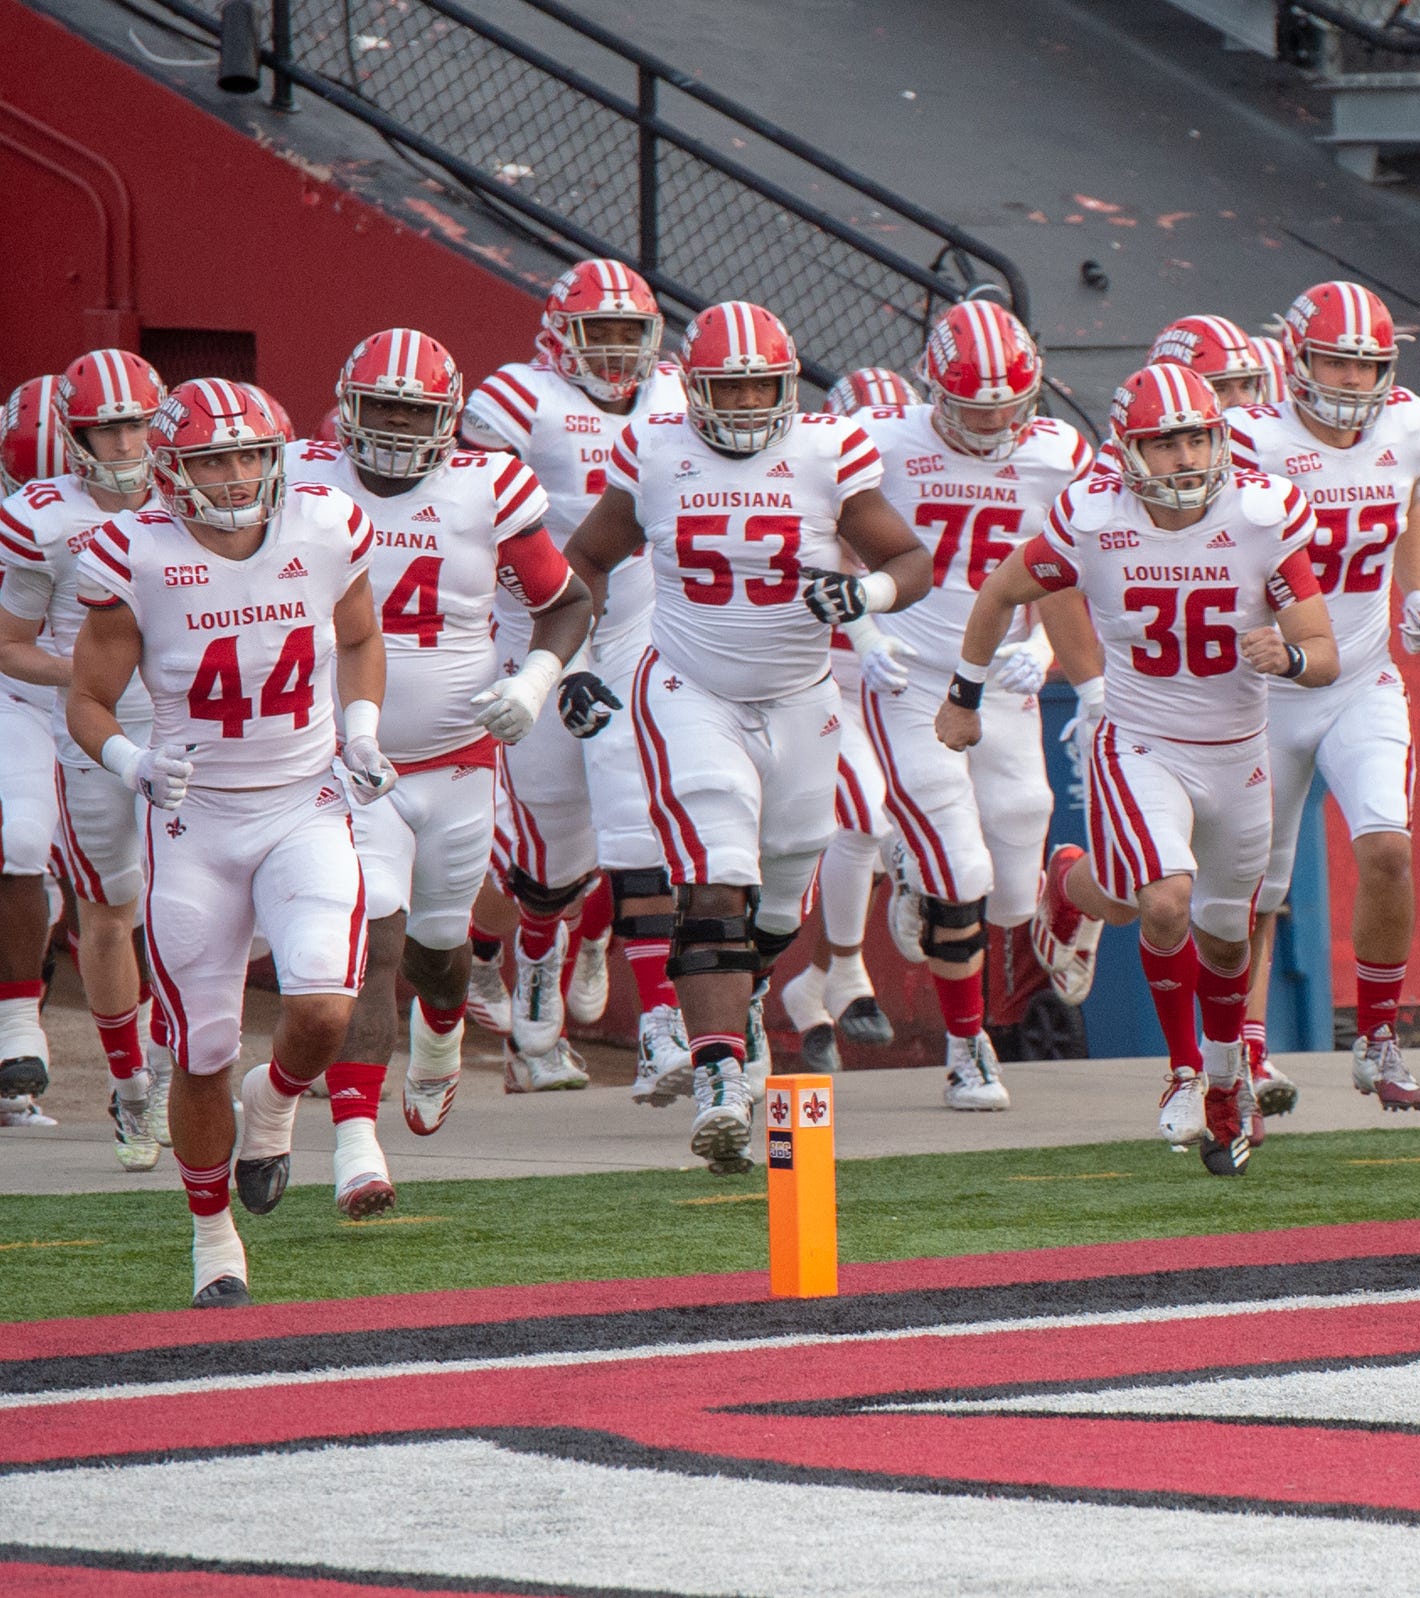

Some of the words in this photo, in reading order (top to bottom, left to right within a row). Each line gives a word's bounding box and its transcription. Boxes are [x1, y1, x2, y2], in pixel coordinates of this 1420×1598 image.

[565, 414, 601, 434] SBC
[906, 453, 945, 477] SBC
[1286, 452, 1323, 476] SBC
[680, 491, 794, 510] LOUISIANA
[919, 482, 1017, 504] LOUISIANA
[1305, 484, 1396, 504] LOUISIANA
[375, 530, 438, 551] SIANA
[914, 502, 1025, 592] 76
[1099, 530, 1141, 551] SBC
[1307, 502, 1401, 596] 82
[675, 513, 803, 607] 53
[164, 563, 210, 588] SBC
[1123, 565, 1231, 582] LOUISIANA
[381, 555, 445, 648] 4
[186, 601, 306, 631] LOUISIANA
[1124, 586, 1240, 678] 36
[187, 624, 316, 739] 44
